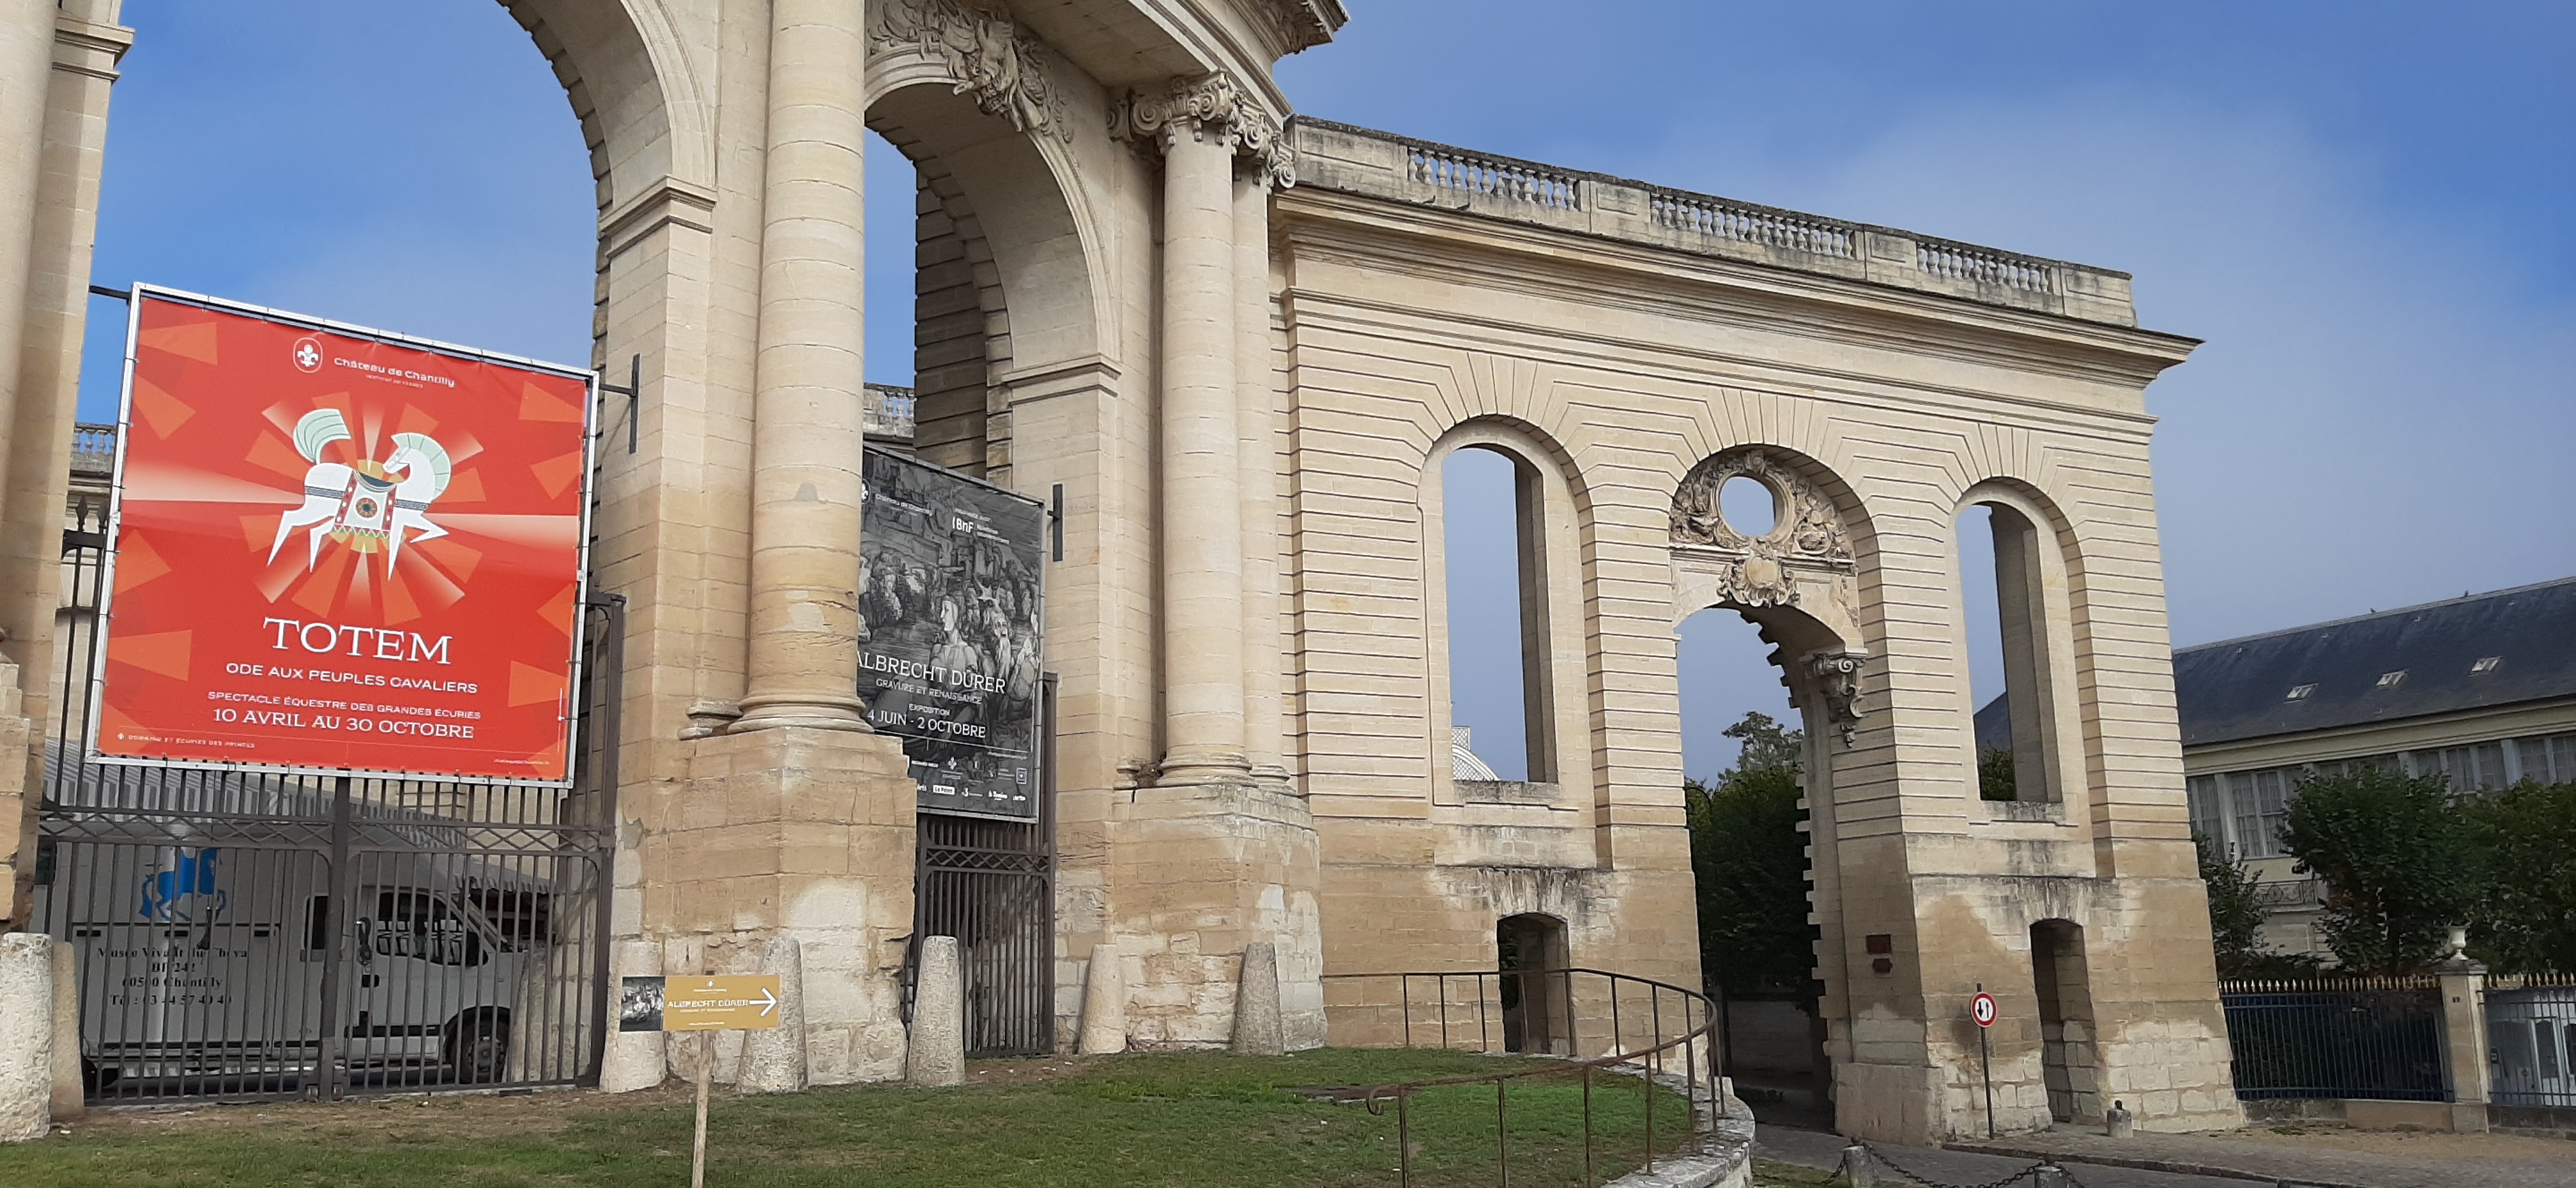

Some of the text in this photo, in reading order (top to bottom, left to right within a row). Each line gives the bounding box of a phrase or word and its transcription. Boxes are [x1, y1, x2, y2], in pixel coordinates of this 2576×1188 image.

[263, 616, 453, 665] TOTEM
[226, 662, 479, 694] ODE AUX PEUPLES CAVALIERS
[876, 678, 914, 694] GRAVURE
[208, 691, 481, 720] SPECTACLE ÉQUESTRE DES GRANDES ÉCURIES
[213, 708, 475, 739] 10 AVRIL AU 30 OCTOBRE
[878, 710, 907, 726] JUIN
[917, 717, 926, 729] 2
[928, 719, 986, 738] OCTOBRE
[122, 977, 160, 987] 050
